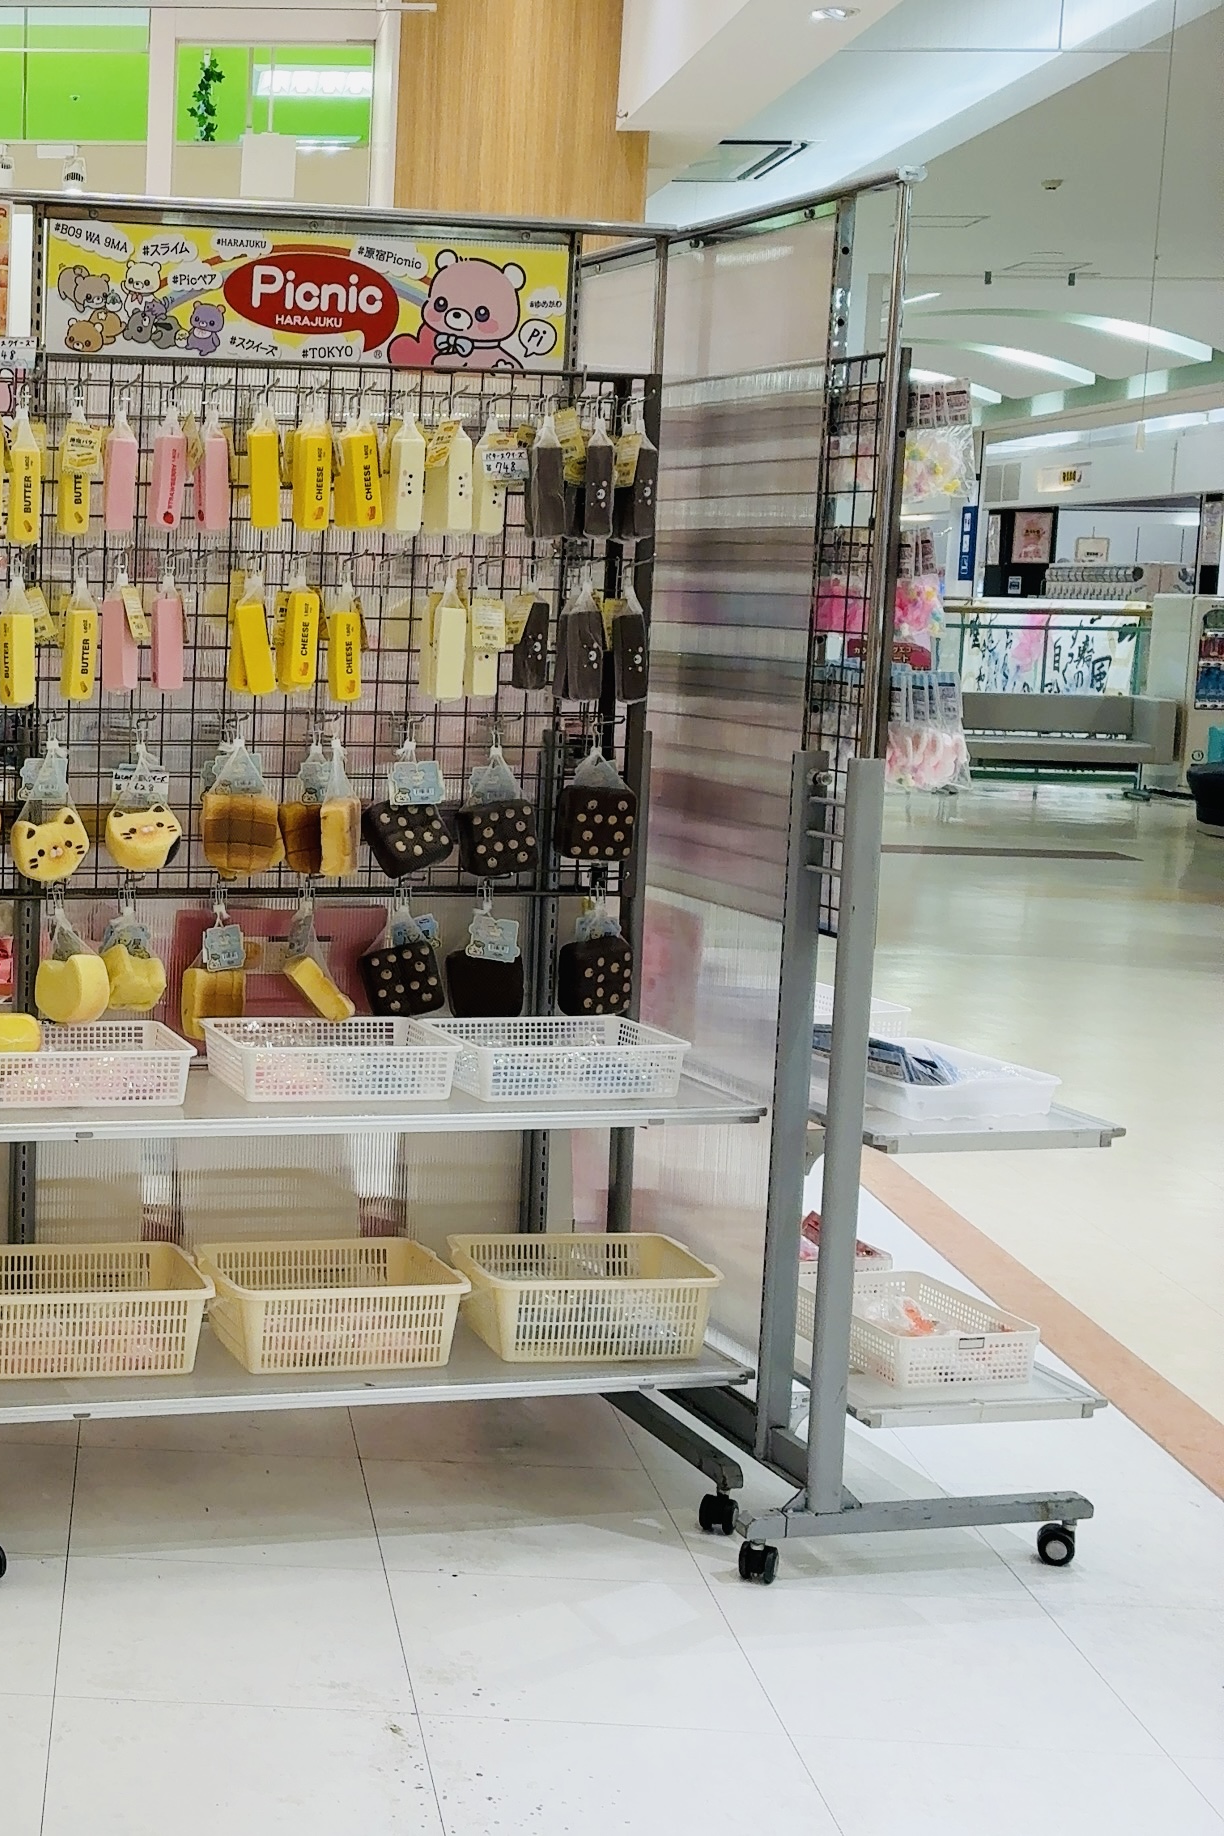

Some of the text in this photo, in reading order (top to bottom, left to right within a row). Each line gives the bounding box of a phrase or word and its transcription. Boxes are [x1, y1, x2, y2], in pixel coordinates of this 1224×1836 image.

[85, 230, 101, 245] WA
[103, 236, 128, 253] 9MA
[142, 241, 190, 256] #スライム
[216, 238, 267, 249] #HARAJUKU
[357, 246, 422, 270] #原宿Picnic
[171, 274, 217, 285] #Picベア
[251, 264, 384, 315] Picnic
[275, 314, 343, 328] HARAJUKU
[229, 336, 278, 357] #スクイーズ
[527, 328, 547, 347] Pi
[301, 345, 353, 359] #TOKYO
[74, 474, 83, 505] BUTTE
[315, 466, 324, 501] CHEESE
[363, 464, 373, 501] CHEESE
[23, 475, 32, 514] BUTTER
[300, 621, 310, 656] CHEESE
[80, 638, 90, 675] BUTTER
